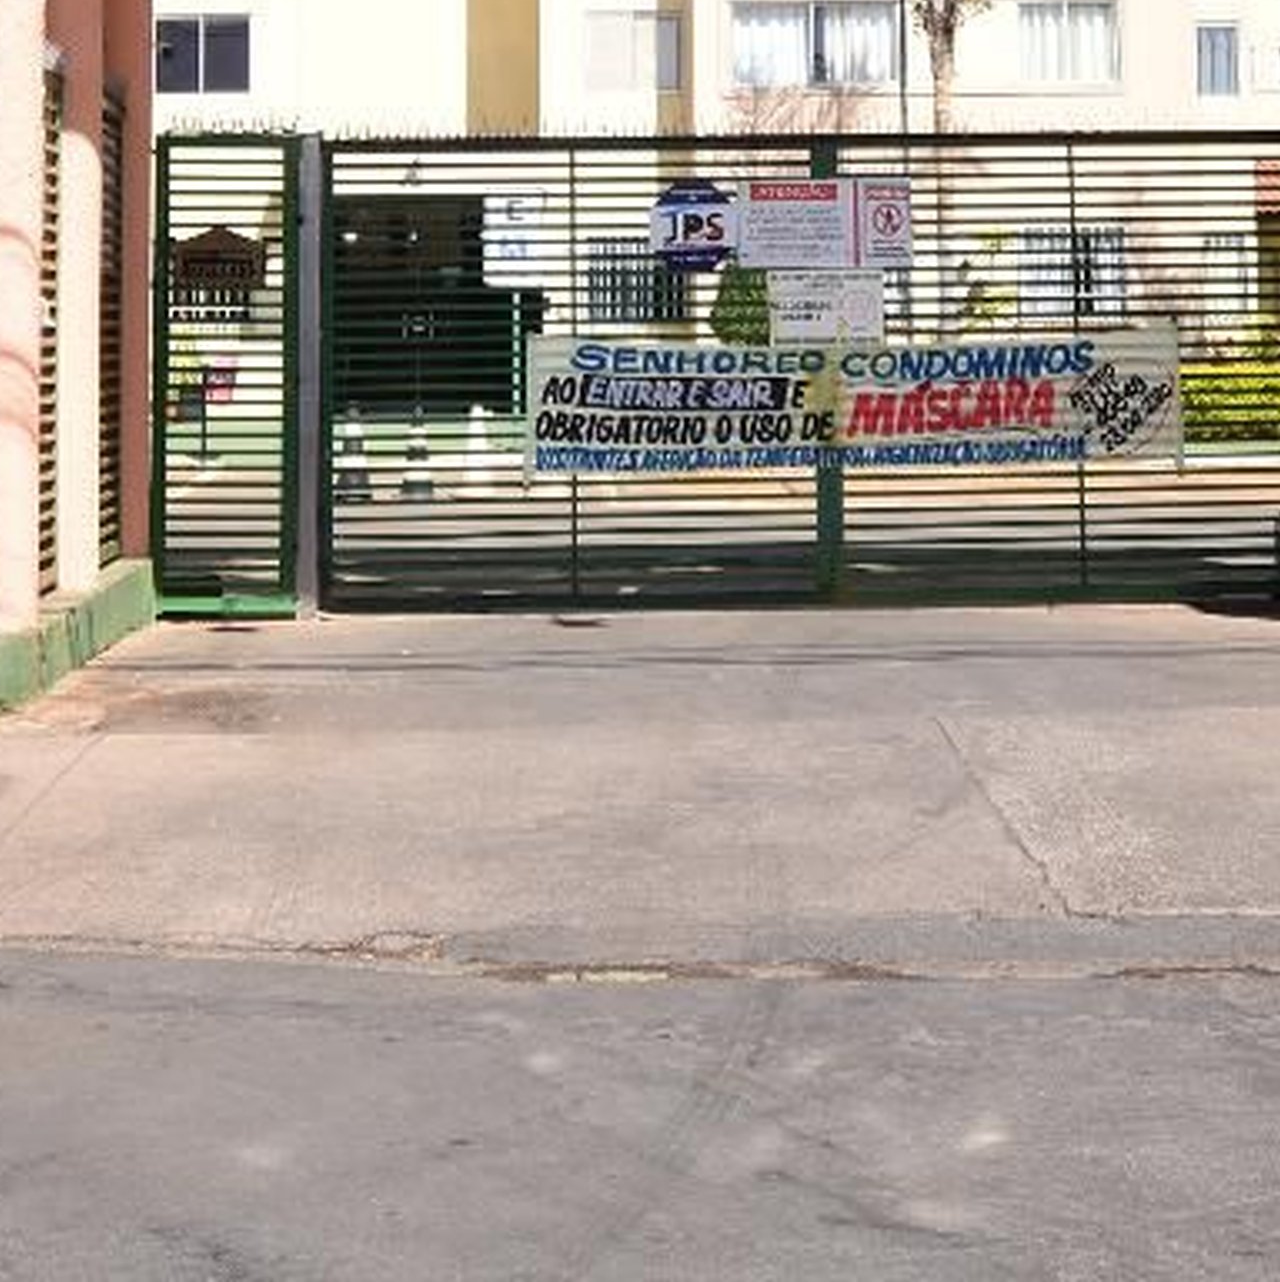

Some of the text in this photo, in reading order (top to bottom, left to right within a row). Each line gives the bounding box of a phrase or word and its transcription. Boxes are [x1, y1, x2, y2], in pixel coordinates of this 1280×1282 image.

[542, 377, 577, 405] AO
[584, 378, 681, 408] ENTRAR
[706, 381, 775, 408] SAIR
[714, 416, 733, 444] O
[739, 415, 793, 443] USO
[800, 411, 835, 442] DE
